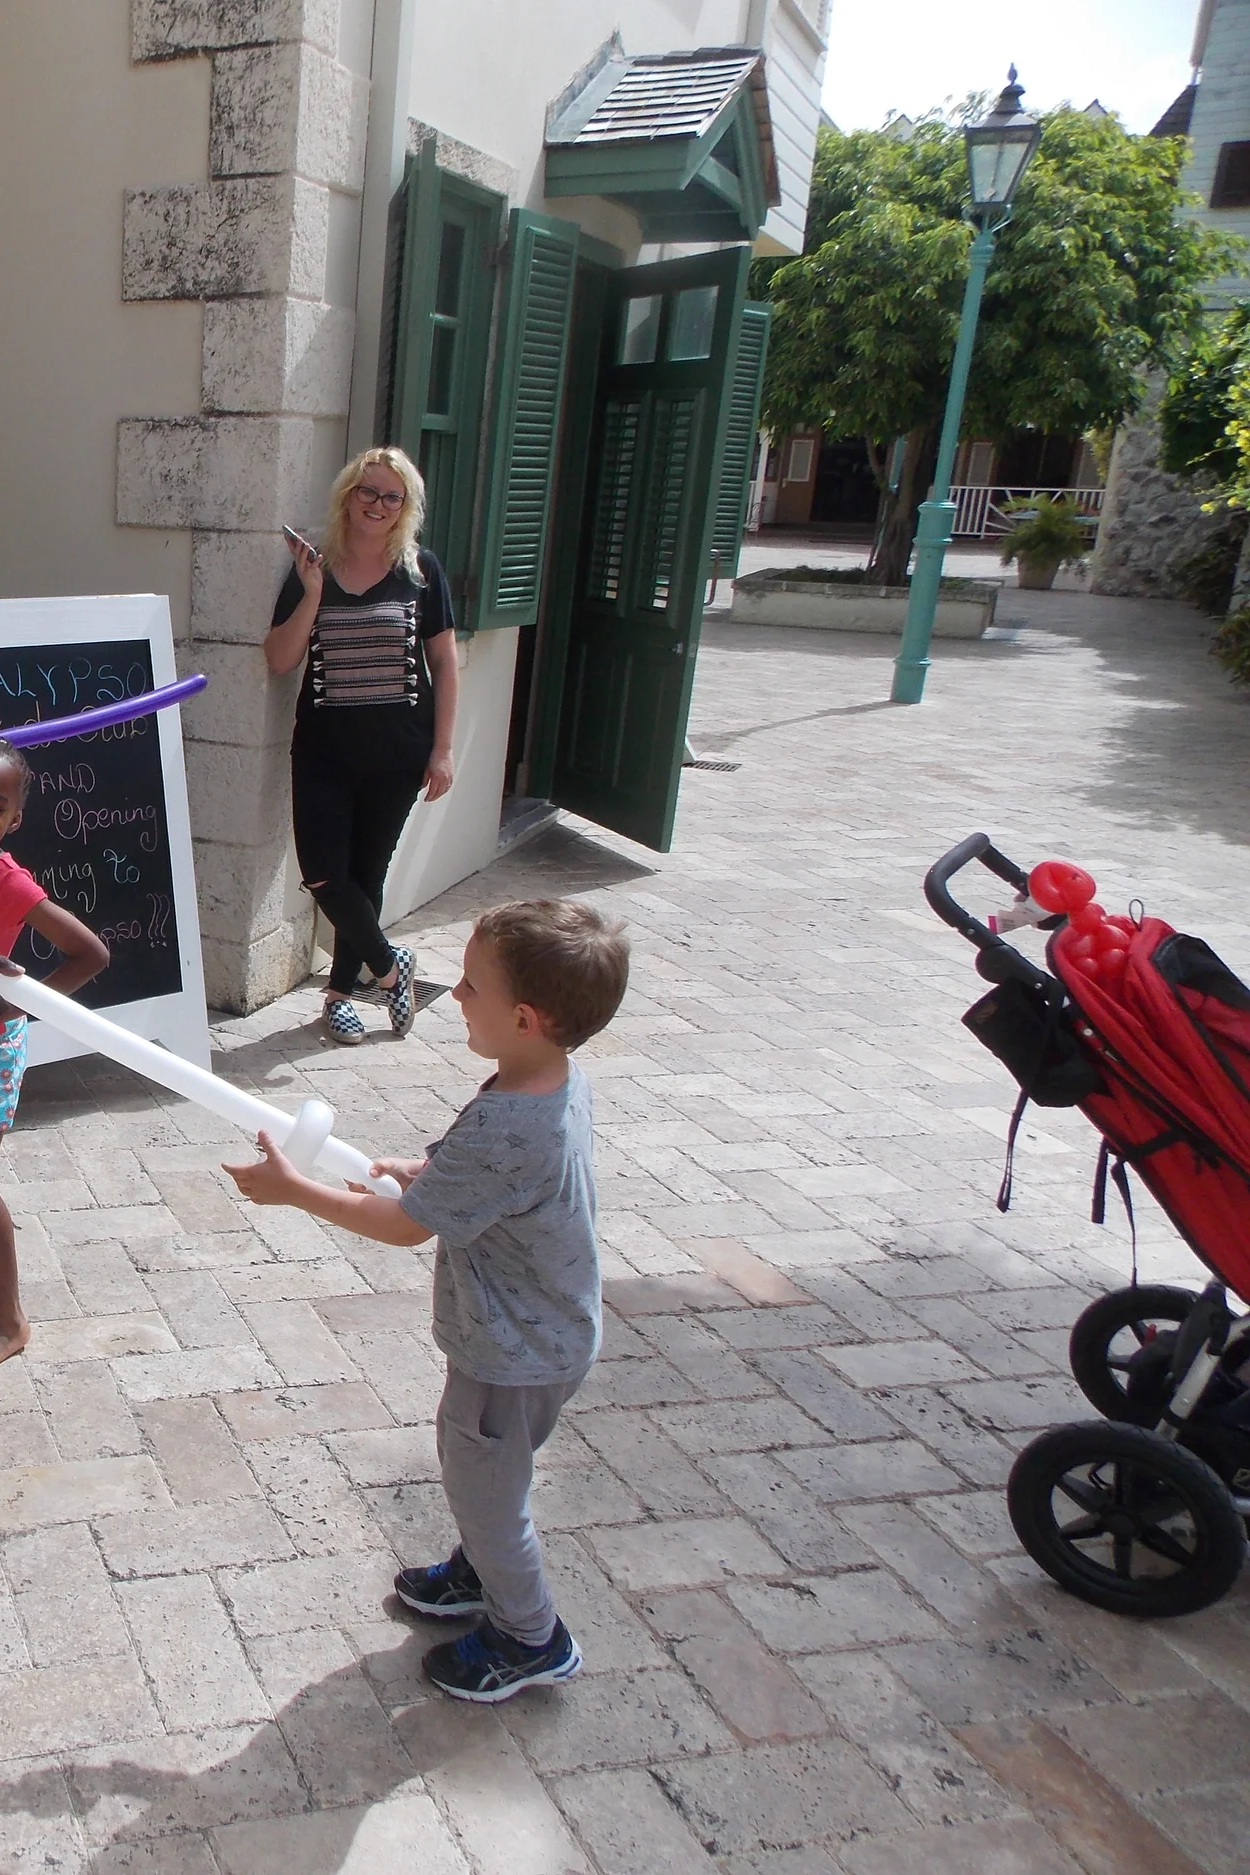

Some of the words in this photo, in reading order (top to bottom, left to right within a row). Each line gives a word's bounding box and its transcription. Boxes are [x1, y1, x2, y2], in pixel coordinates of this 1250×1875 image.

[30, 763, 96, 795] AND
[54, 798, 158, 852] Opening
[32, 849, 97, 914] ming
